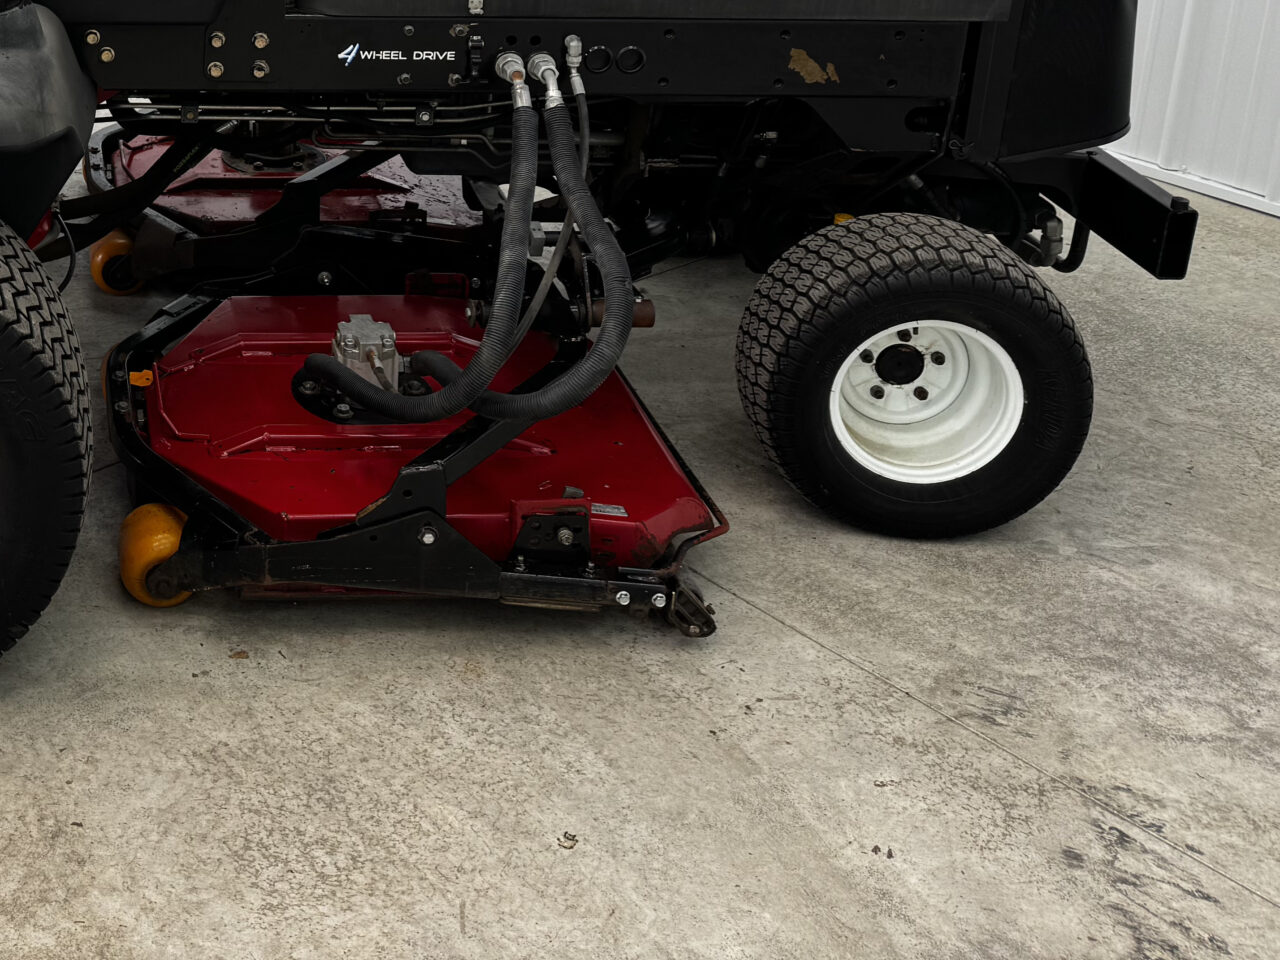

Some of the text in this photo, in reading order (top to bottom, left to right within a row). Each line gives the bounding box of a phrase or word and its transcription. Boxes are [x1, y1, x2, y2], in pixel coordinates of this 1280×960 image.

[337, 42, 456, 67] 4 WHEEL DRIVE
